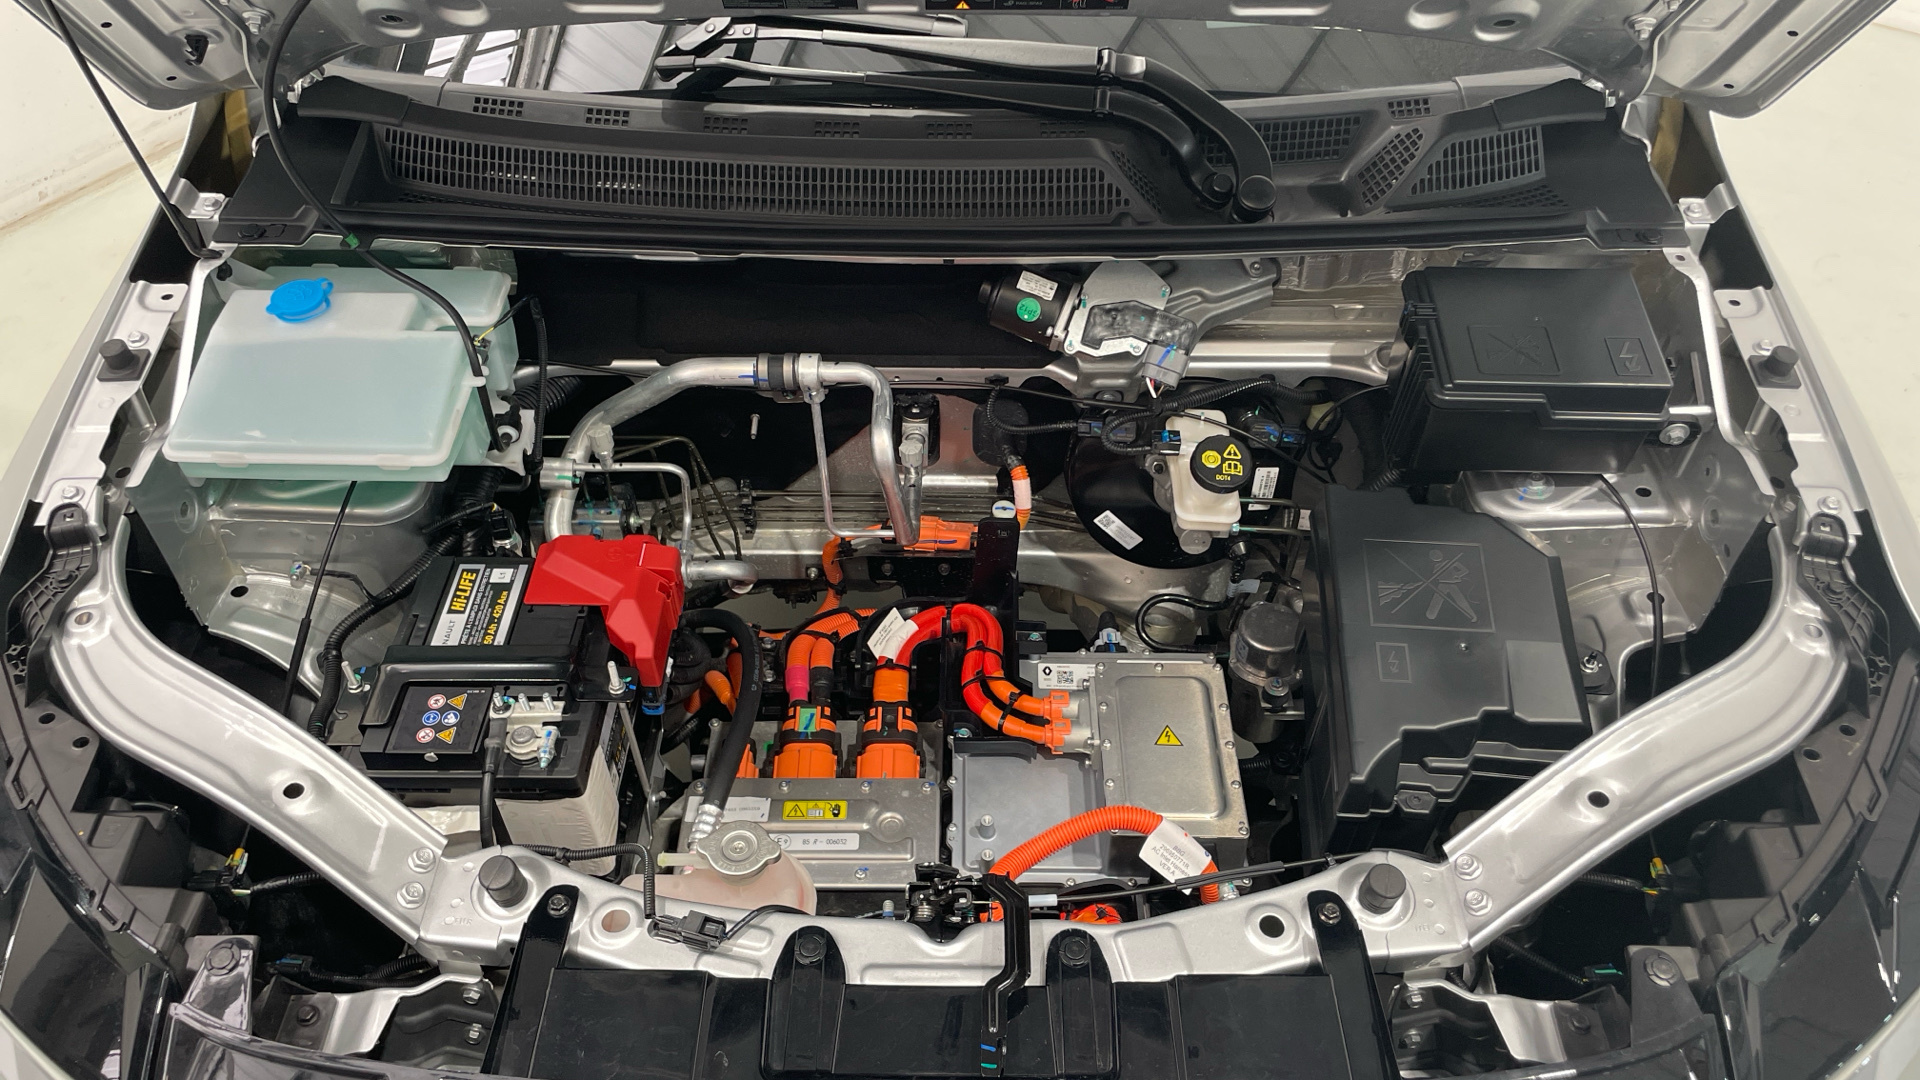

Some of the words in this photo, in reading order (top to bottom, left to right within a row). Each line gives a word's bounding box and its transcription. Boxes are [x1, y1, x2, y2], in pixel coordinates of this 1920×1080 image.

[483, 635, 494, 645] 50
[492, 604, 504, 618] 420
[1151, 846, 1160, 855] AC
